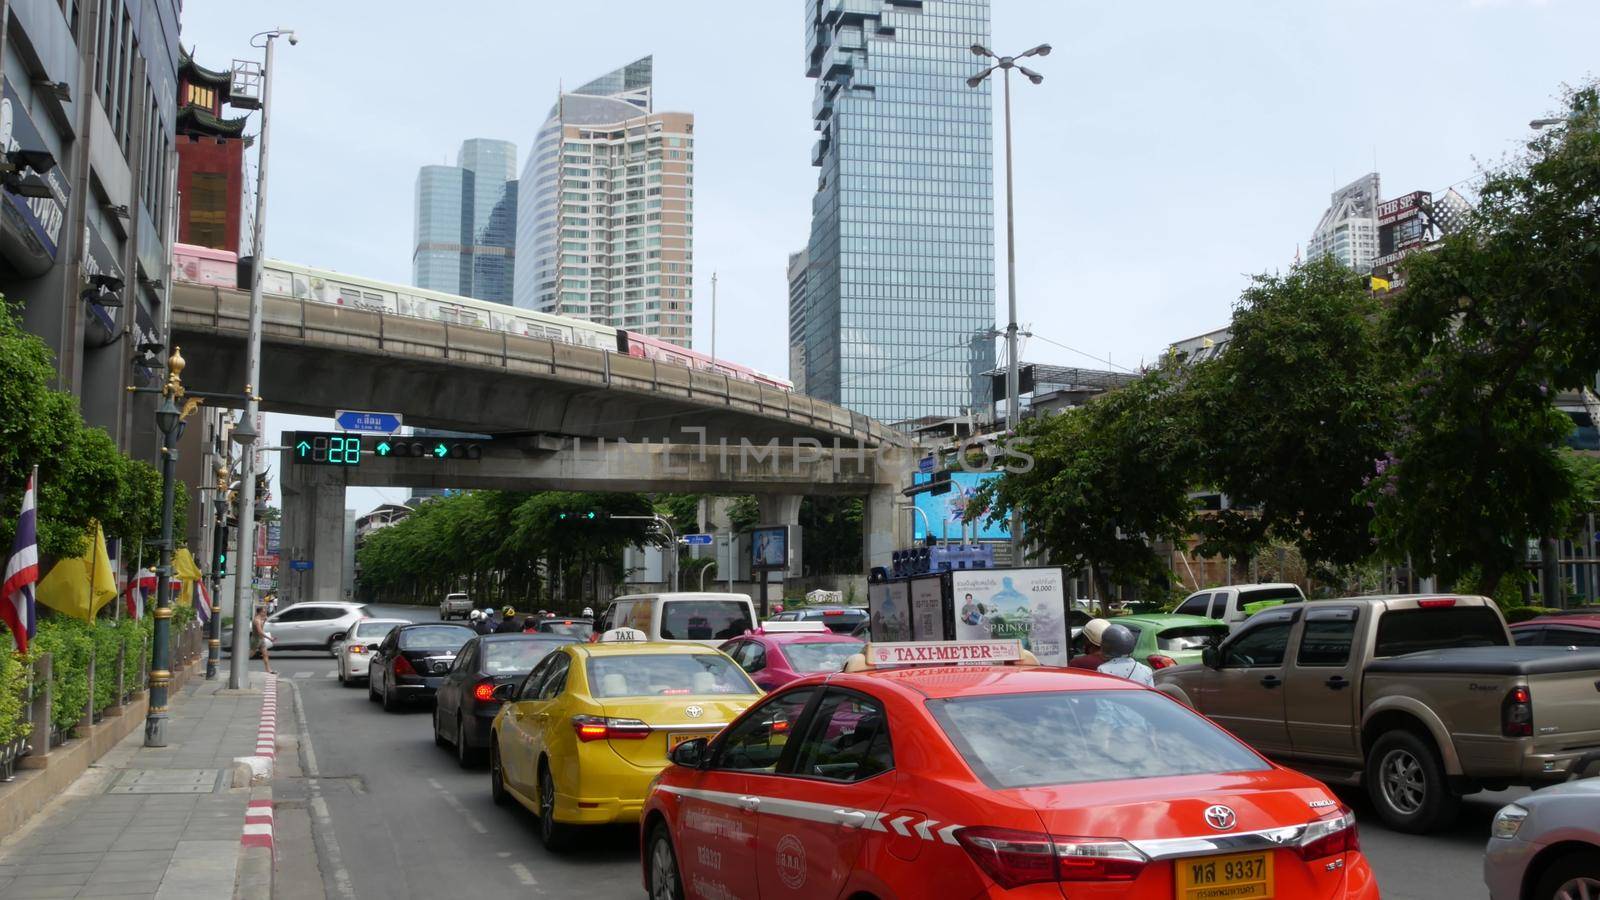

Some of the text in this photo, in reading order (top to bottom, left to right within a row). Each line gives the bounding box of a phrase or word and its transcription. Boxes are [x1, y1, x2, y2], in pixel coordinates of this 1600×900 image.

[1377, 200, 1398, 217] THE
[328, 436, 361, 464] 28
[615, 631, 635, 640] TAXI
[894, 645, 992, 662] TAXI-METER
[1192, 857, 1265, 883] ทส 9337
